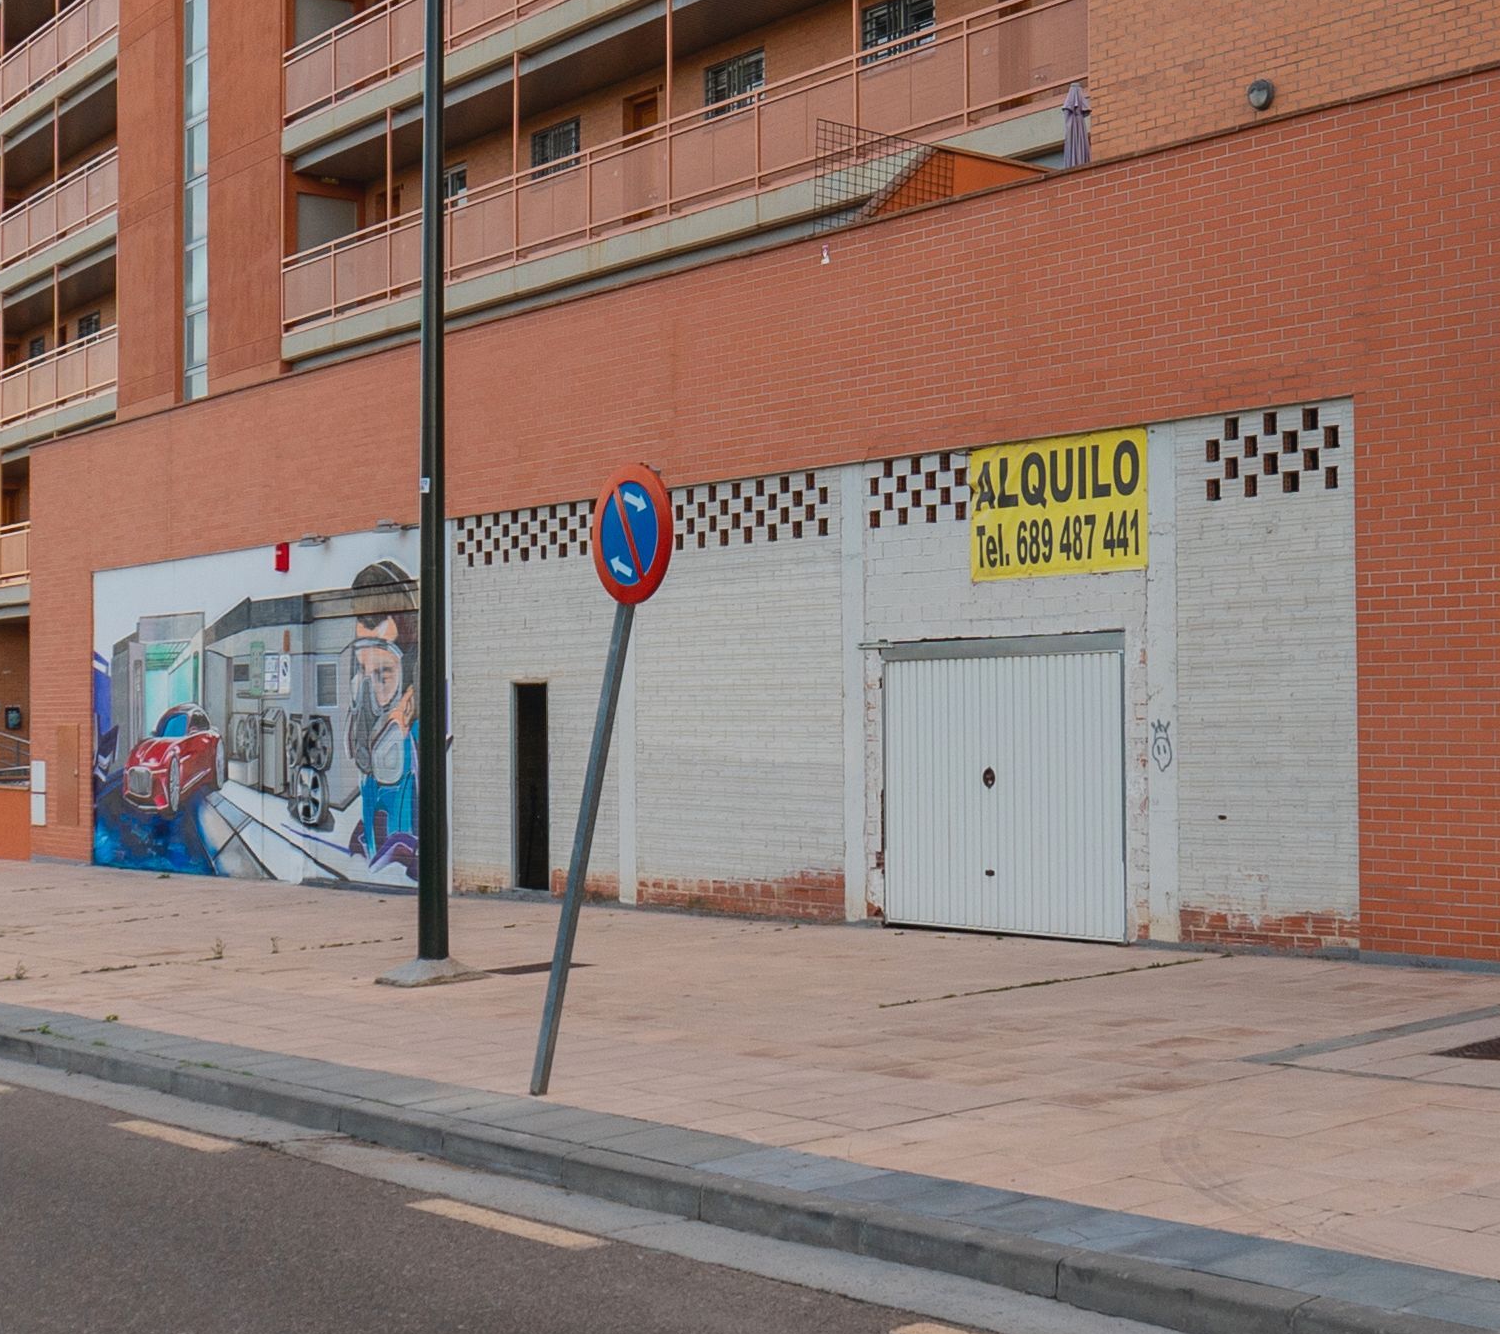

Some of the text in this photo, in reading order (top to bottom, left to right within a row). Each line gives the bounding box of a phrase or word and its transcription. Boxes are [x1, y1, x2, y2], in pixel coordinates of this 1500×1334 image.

[975, 440, 1140, 511] ALQUILO
[976, 509, 1139, 568] Tel. 689 487 441
